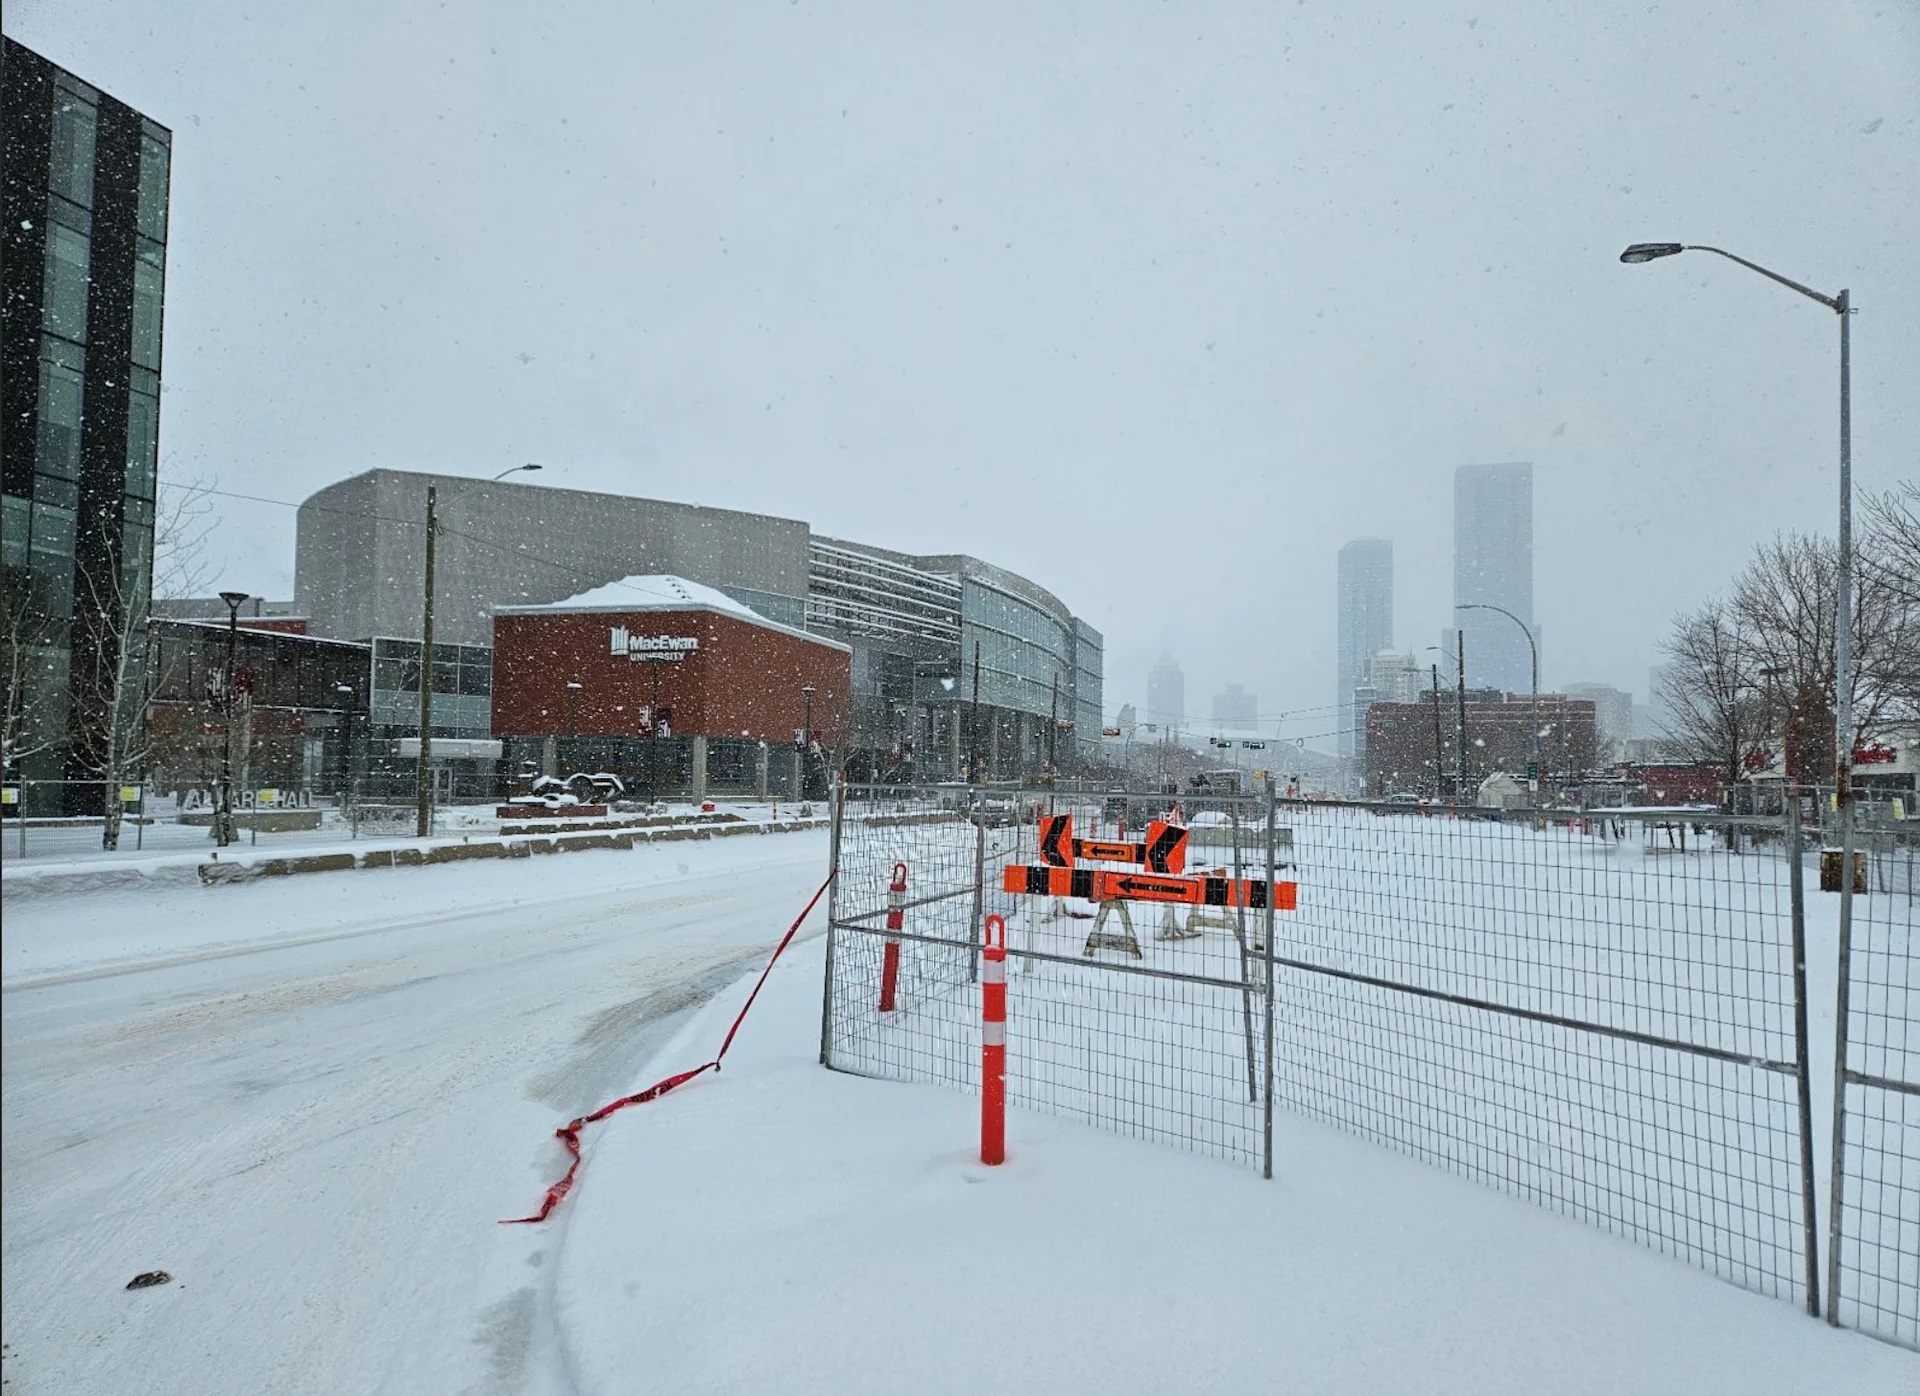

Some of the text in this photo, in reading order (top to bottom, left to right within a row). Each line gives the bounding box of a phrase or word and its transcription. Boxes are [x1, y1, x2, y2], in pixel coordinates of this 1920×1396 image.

[629, 635, 699, 650] MacEwan
[185, 789, 318, 810] ALAR HALL
